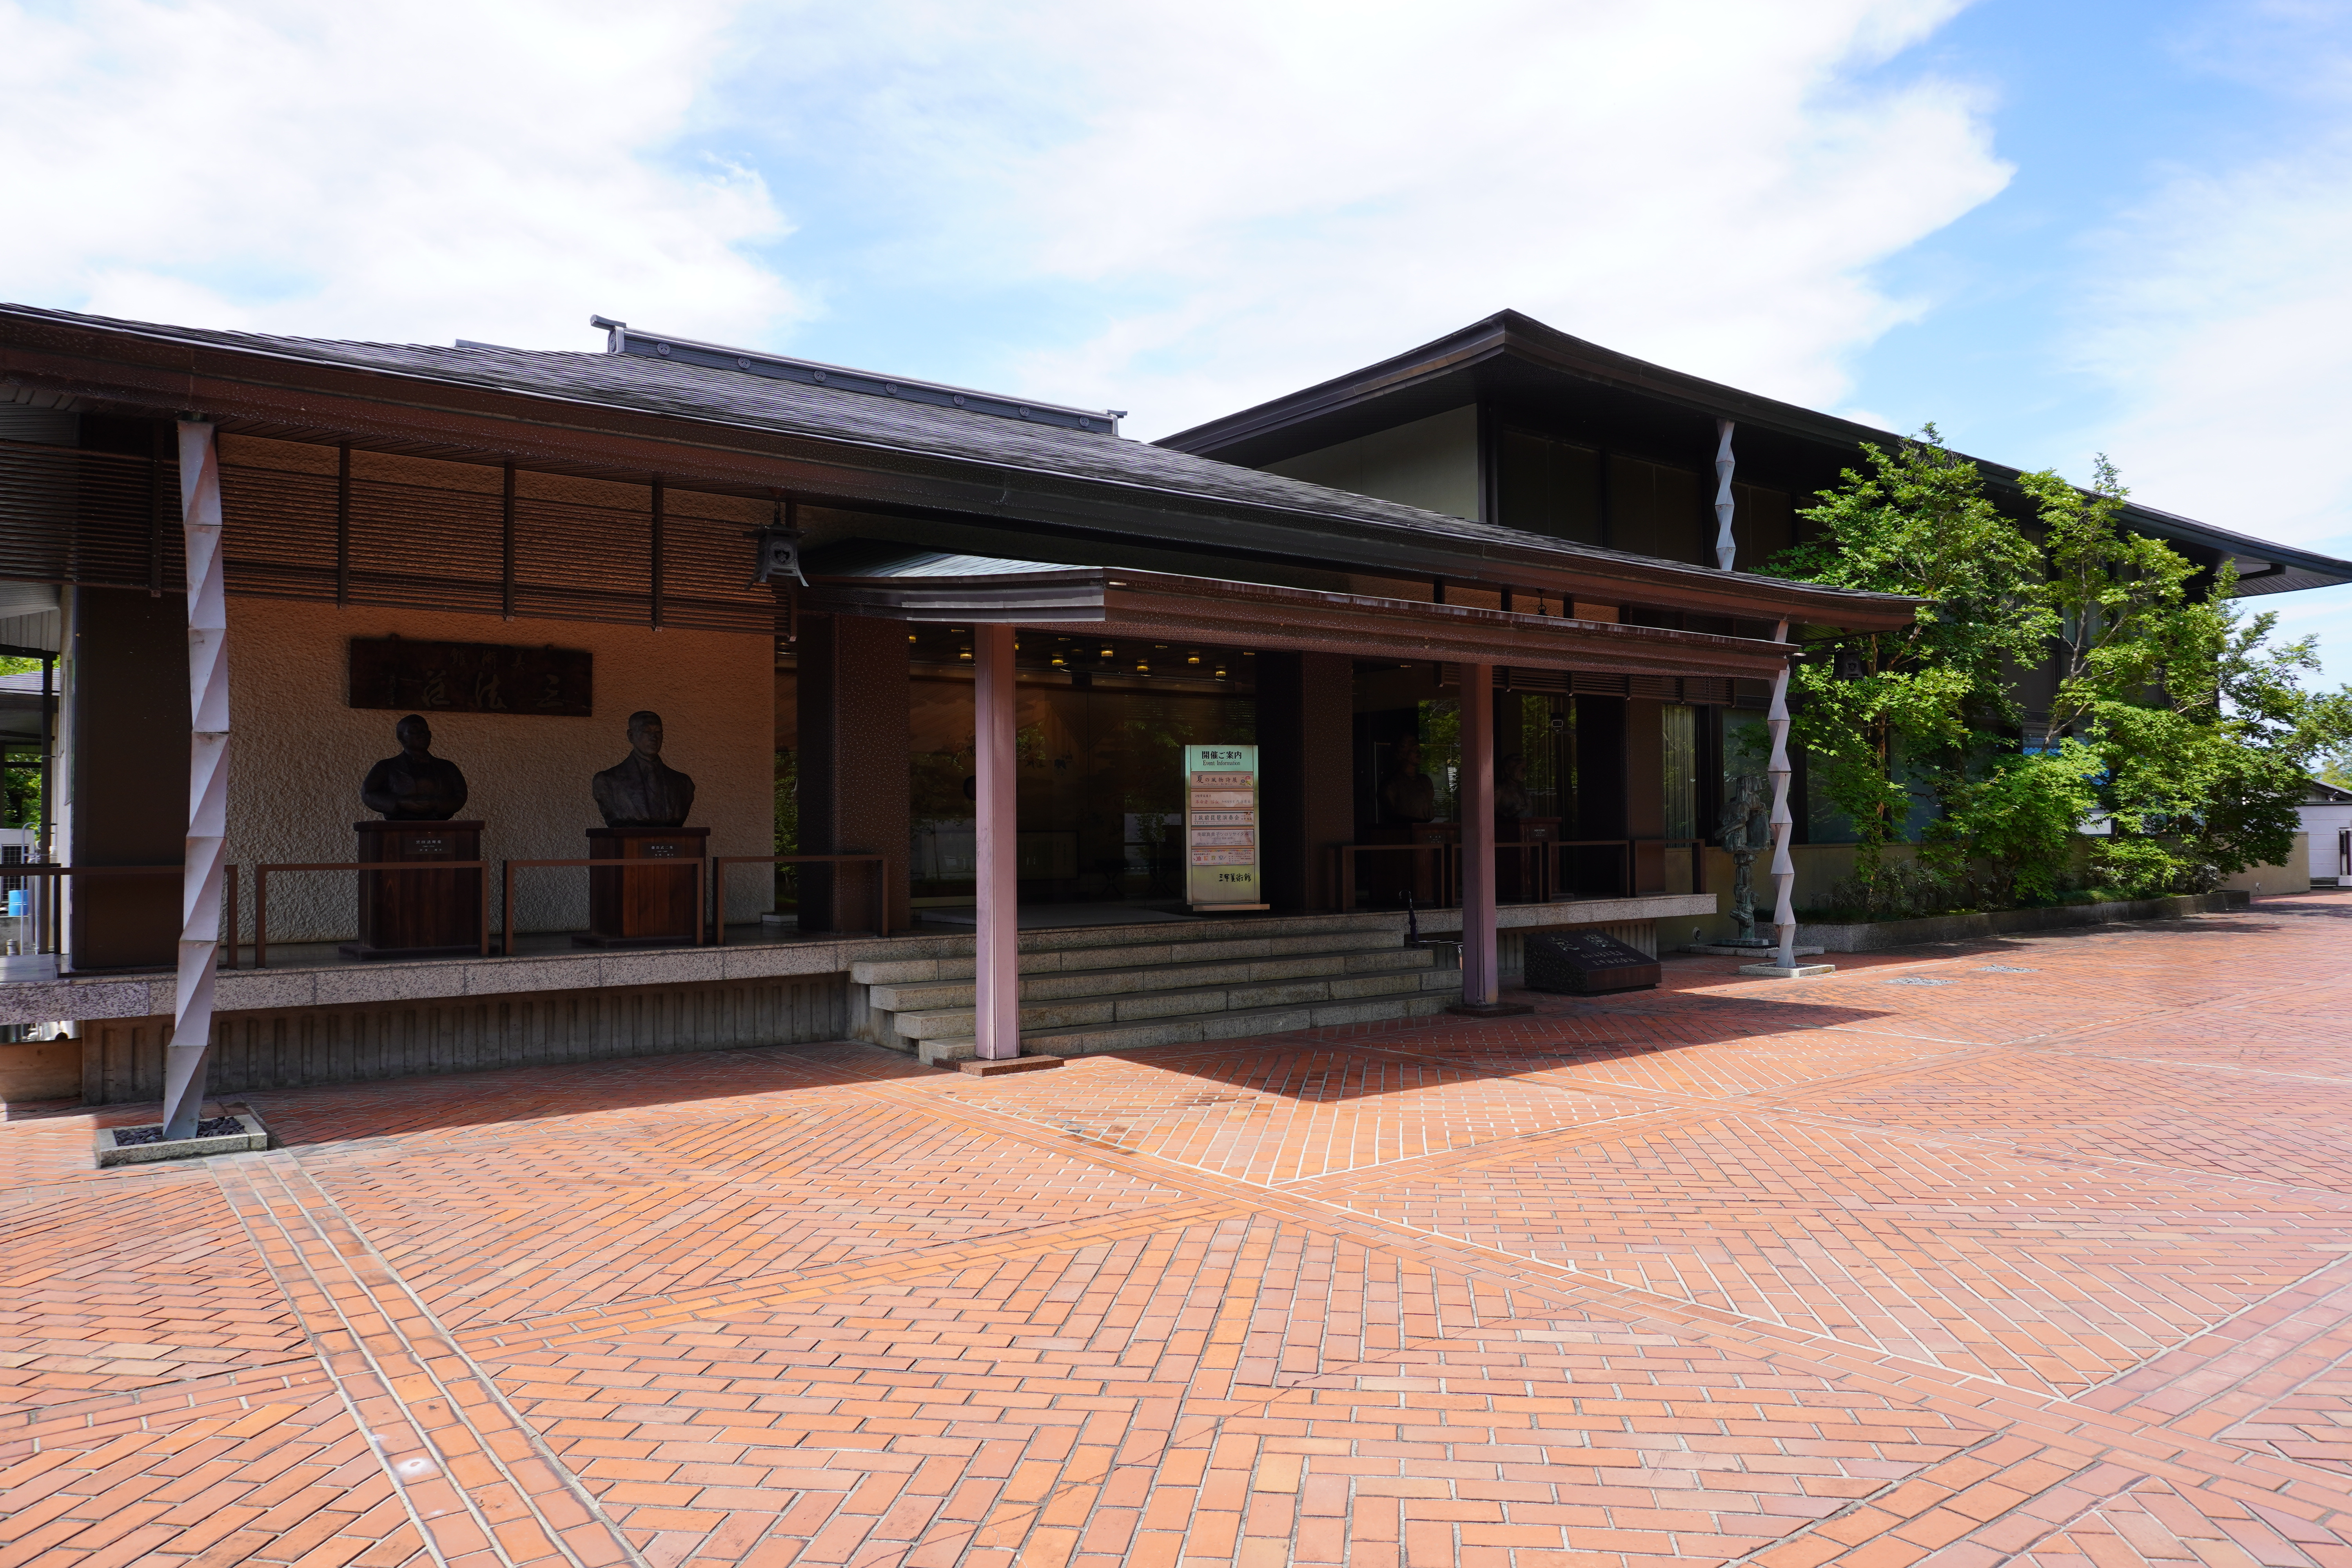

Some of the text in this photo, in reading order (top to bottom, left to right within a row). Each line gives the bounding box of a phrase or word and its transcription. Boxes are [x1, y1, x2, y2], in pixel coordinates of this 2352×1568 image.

[1196, 775, 1238, 783] 夏の風物詩展
[1219, 873, 1252, 882] 三甲美術館
